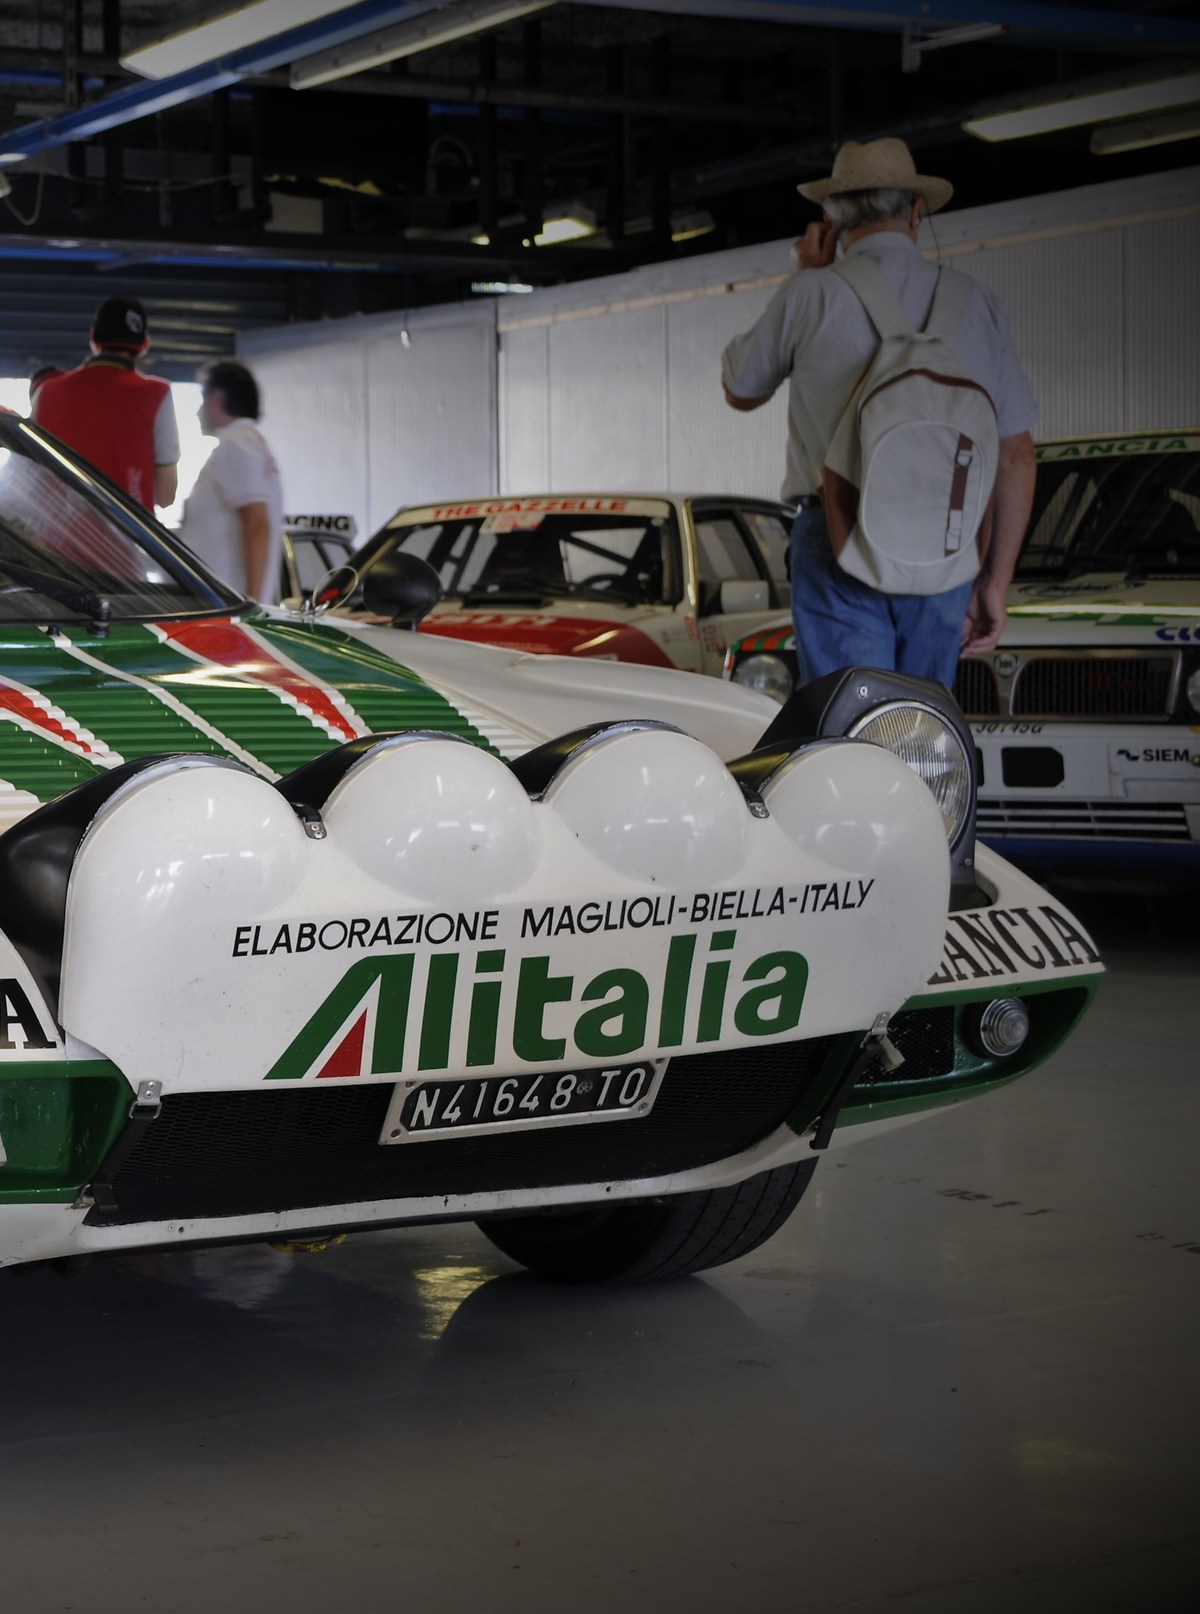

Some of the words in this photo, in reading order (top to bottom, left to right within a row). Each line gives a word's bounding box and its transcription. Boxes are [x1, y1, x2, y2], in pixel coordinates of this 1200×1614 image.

[1035, 439, 1188, 460] LANCIA
[232, 910, 500, 958] ELABORAZIONE
[520, 878, 875, 938] MAGLIOLI-BIELLA-ITALY
[263, 929, 810, 1080] Alitalia
[410, 1073, 577, 1128] N41648
[596, 1067, 647, 1107] TO
